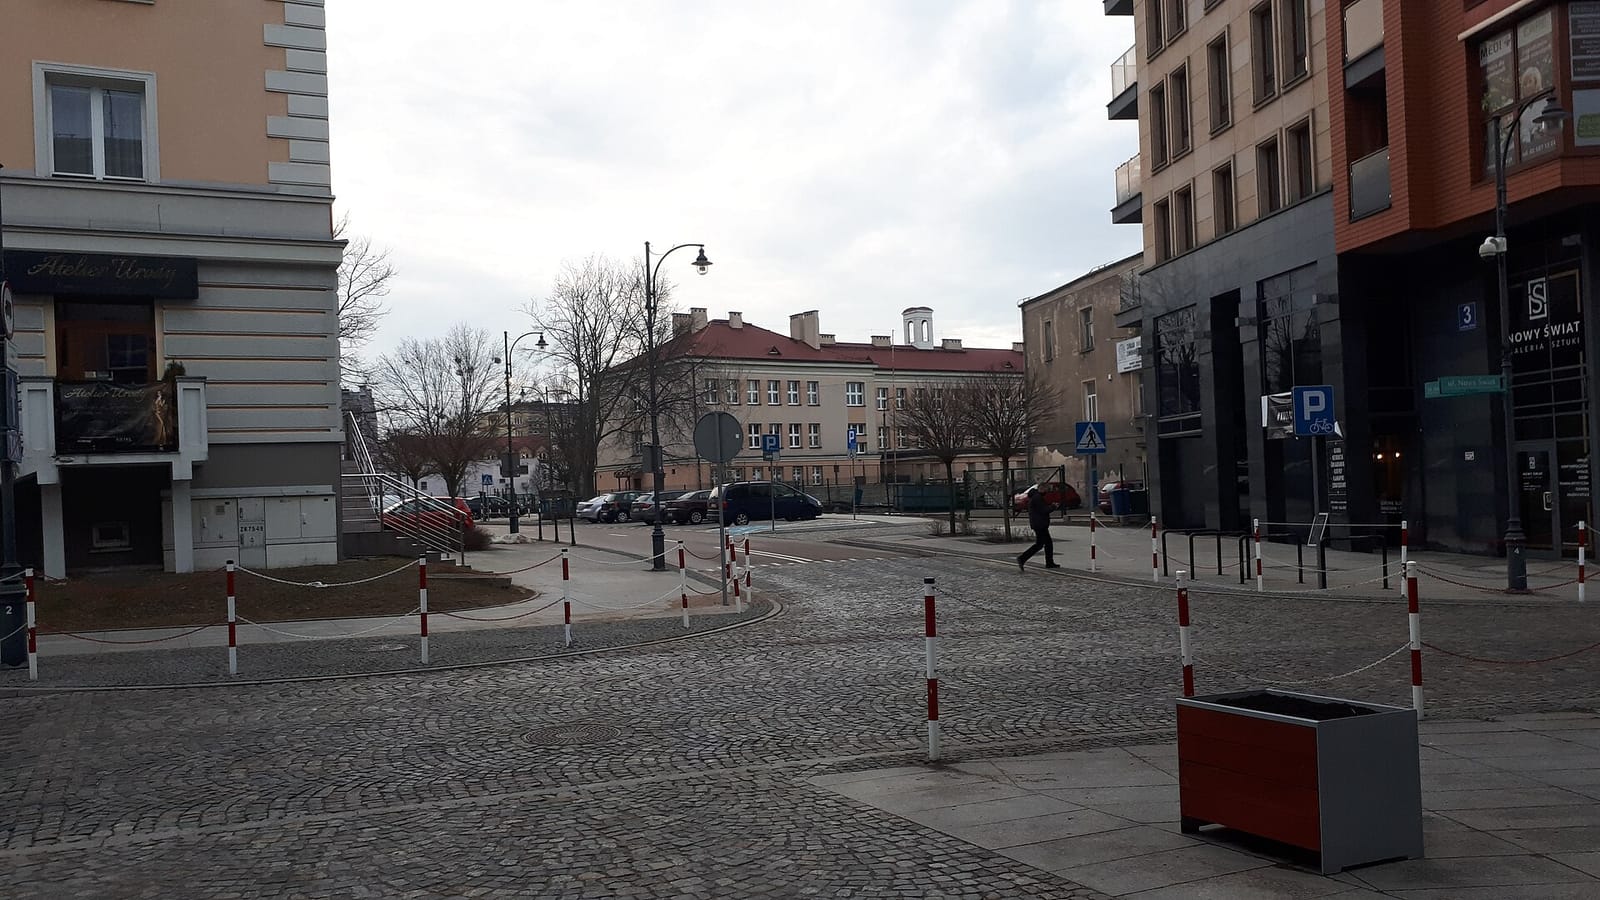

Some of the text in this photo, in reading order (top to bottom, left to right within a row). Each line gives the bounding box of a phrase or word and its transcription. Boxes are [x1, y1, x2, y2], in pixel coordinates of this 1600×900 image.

[27, 255, 109, 278] Atelier
[1463, 305, 1472, 324] 3
[1508, 320, 1581, 344] NOWY ŚWIAT
[1513, 337, 1580, 355] ALERIA SZTUKI
[64, 387, 109, 399] Atelier
[1303, 390, 1326, 421] P
[766, 436, 776, 450] P
[849, 430, 855, 444] P
[1514, 547, 1520, 555] 4
[5, 605, 13, 615] 2
